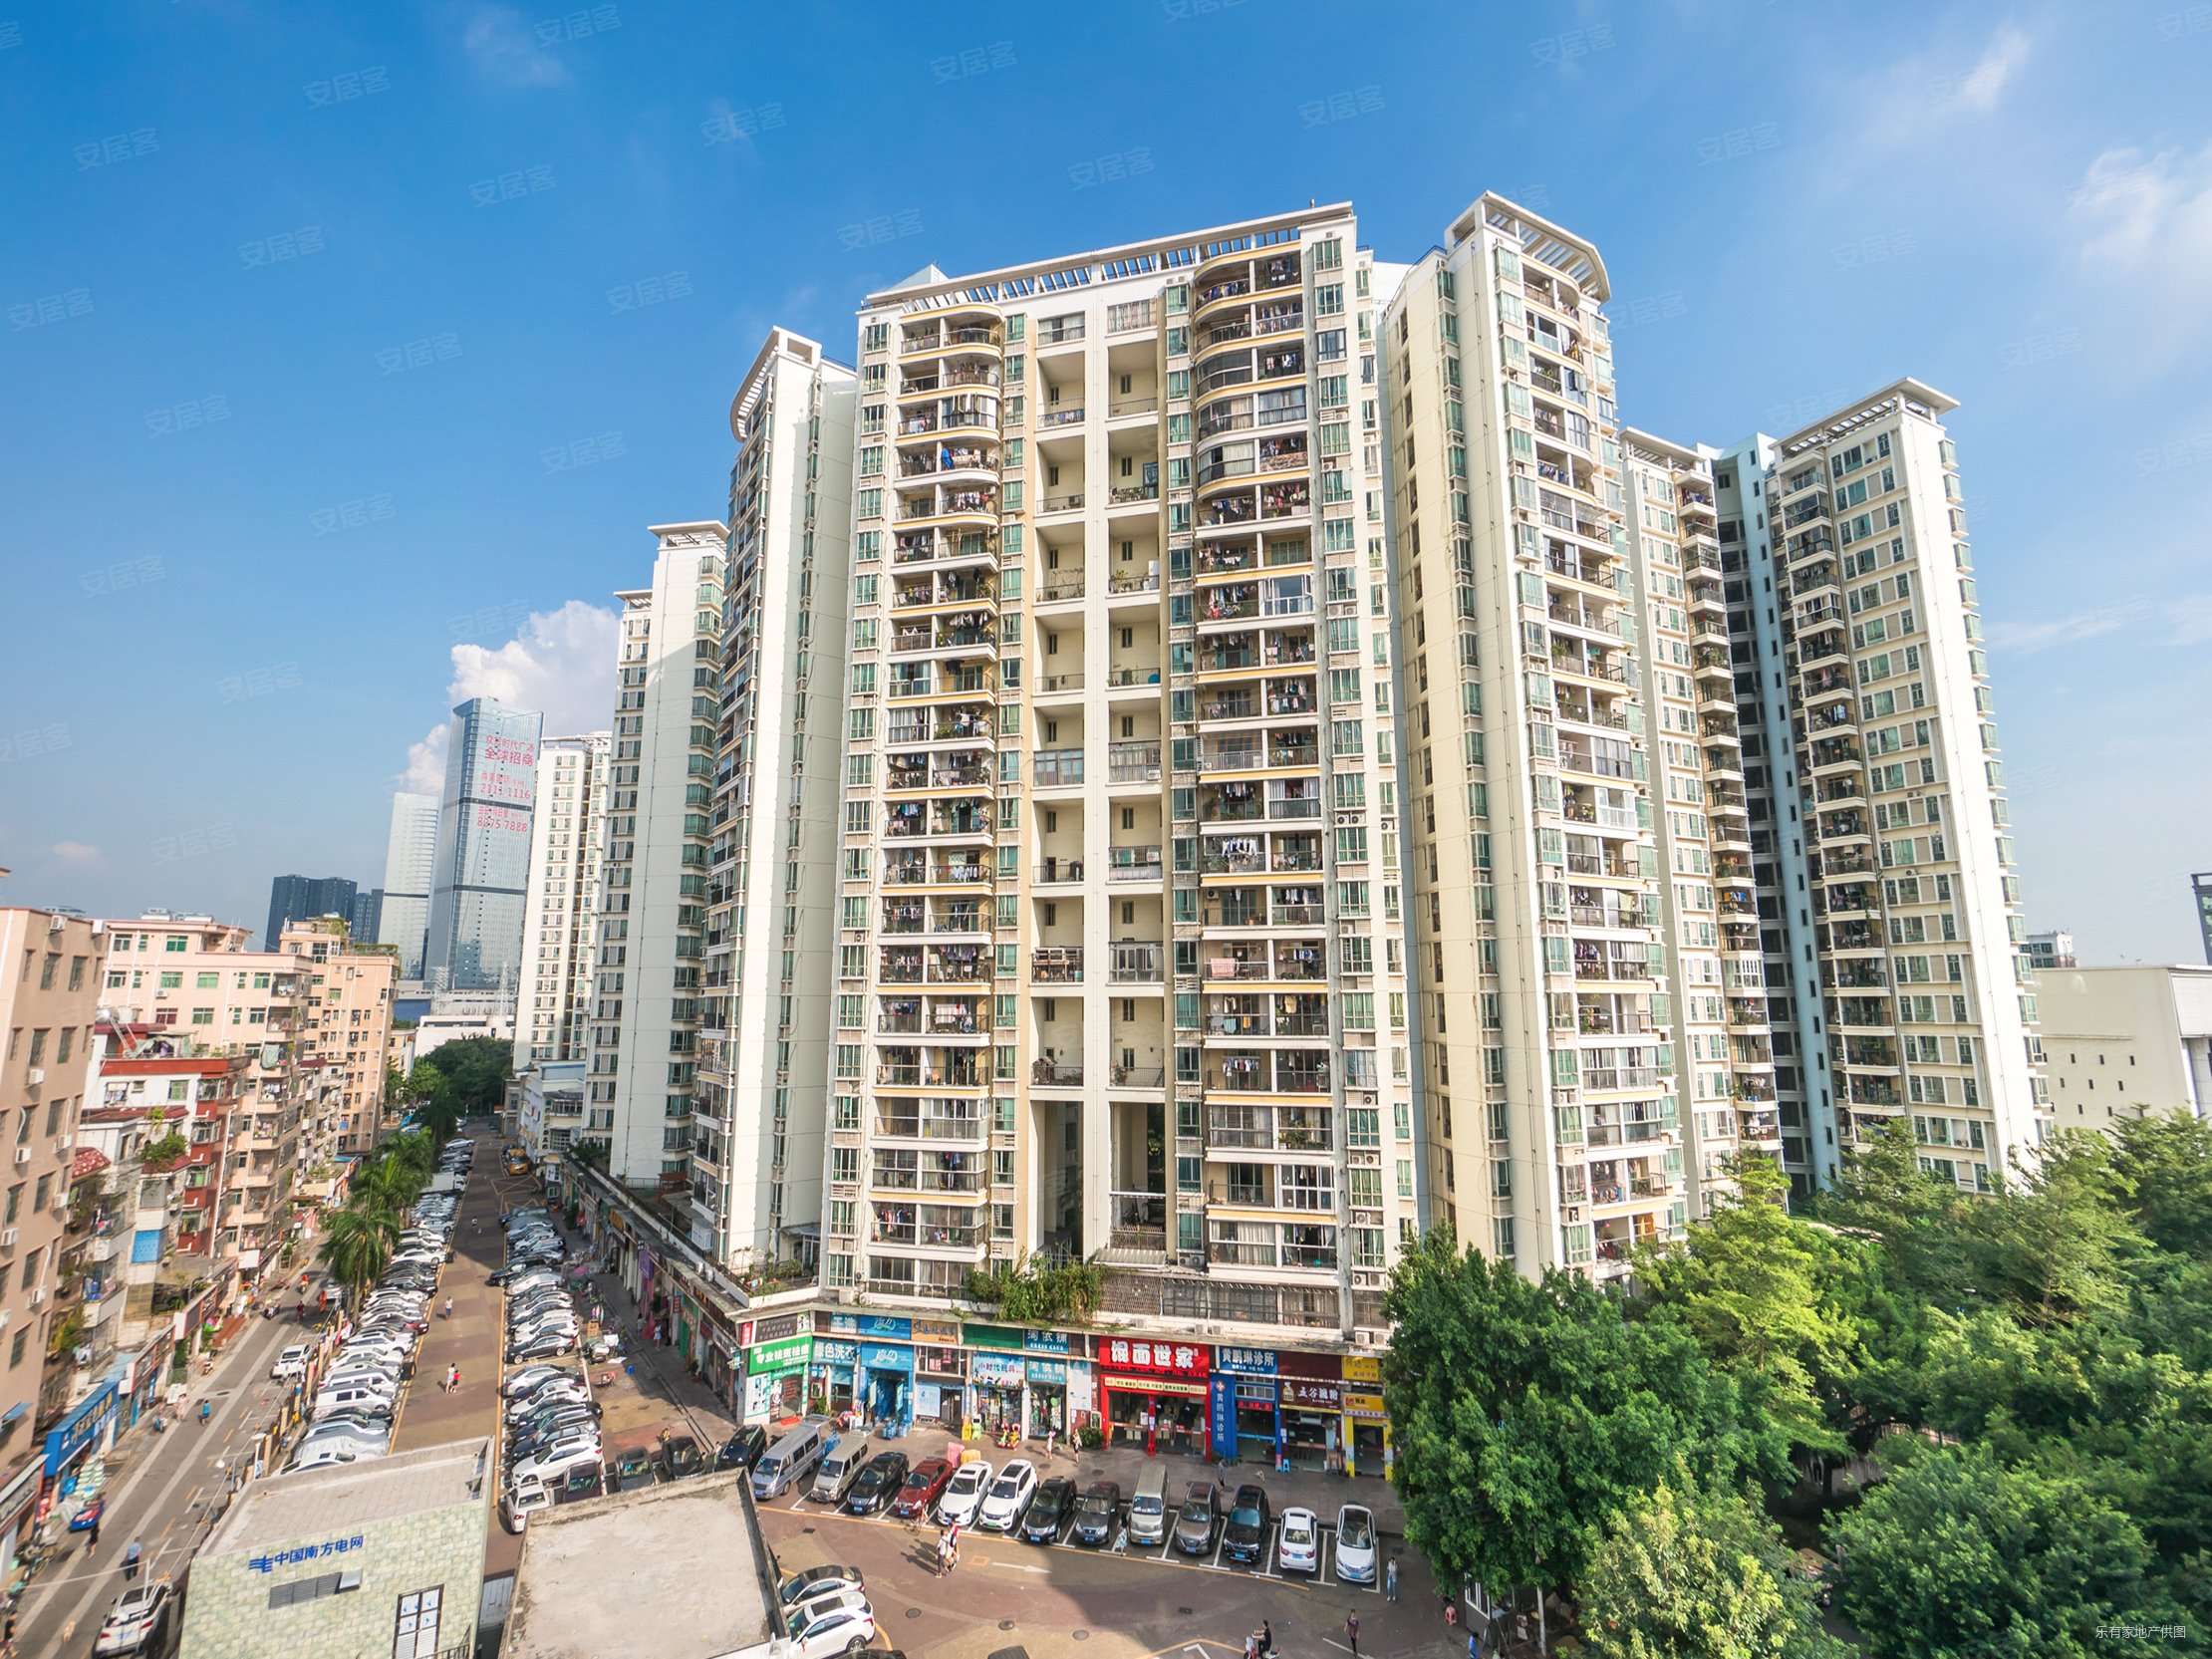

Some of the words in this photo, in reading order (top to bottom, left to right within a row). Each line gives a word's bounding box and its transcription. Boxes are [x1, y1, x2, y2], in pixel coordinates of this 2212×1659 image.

[484, 746, 533, 766] 全球招商
[274, 1535, 364, 1566] 中国南方电网
